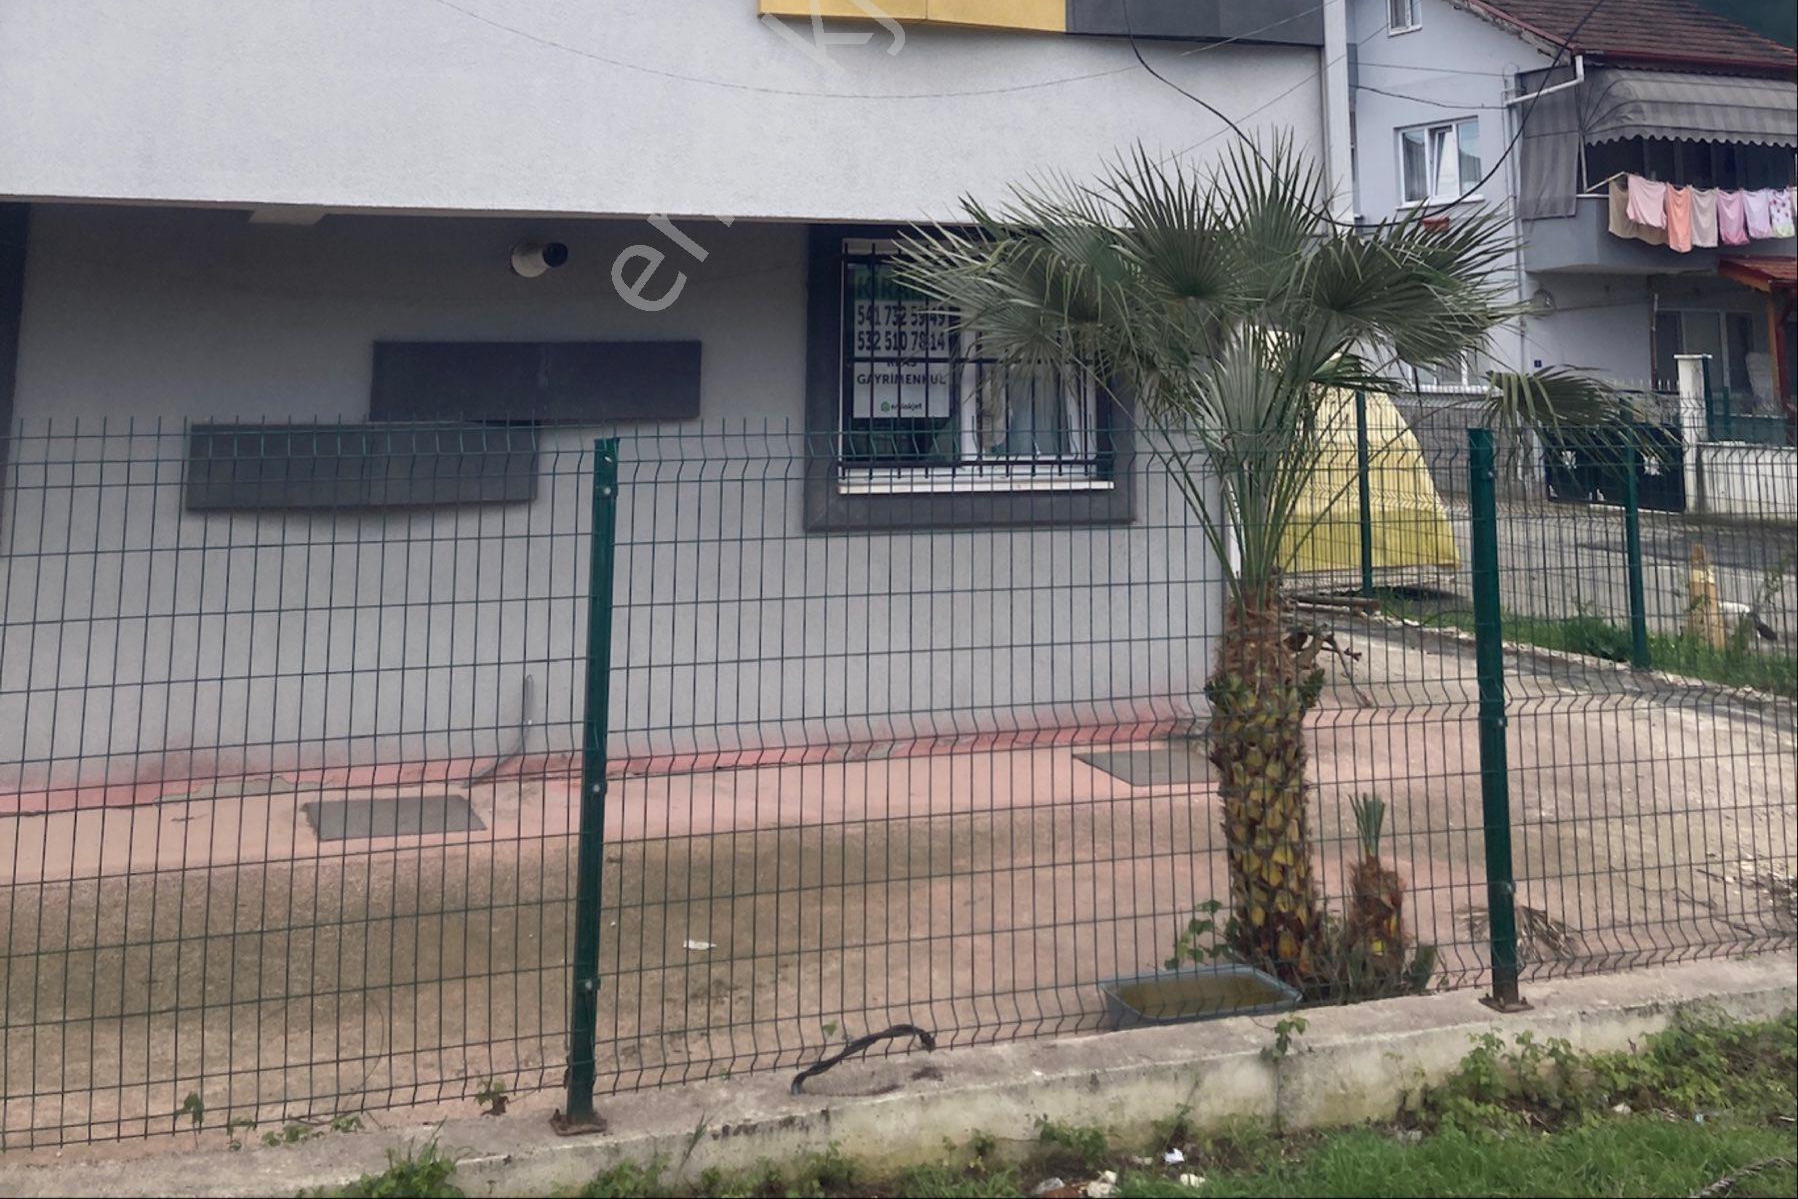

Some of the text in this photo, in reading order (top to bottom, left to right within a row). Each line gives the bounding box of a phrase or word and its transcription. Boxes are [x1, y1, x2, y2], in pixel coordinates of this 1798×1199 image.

[857, 305, 881, 326] 541
[857, 330, 881, 351] 532
[884, 330, 908, 351] 510
[930, 330, 946, 351] 14
